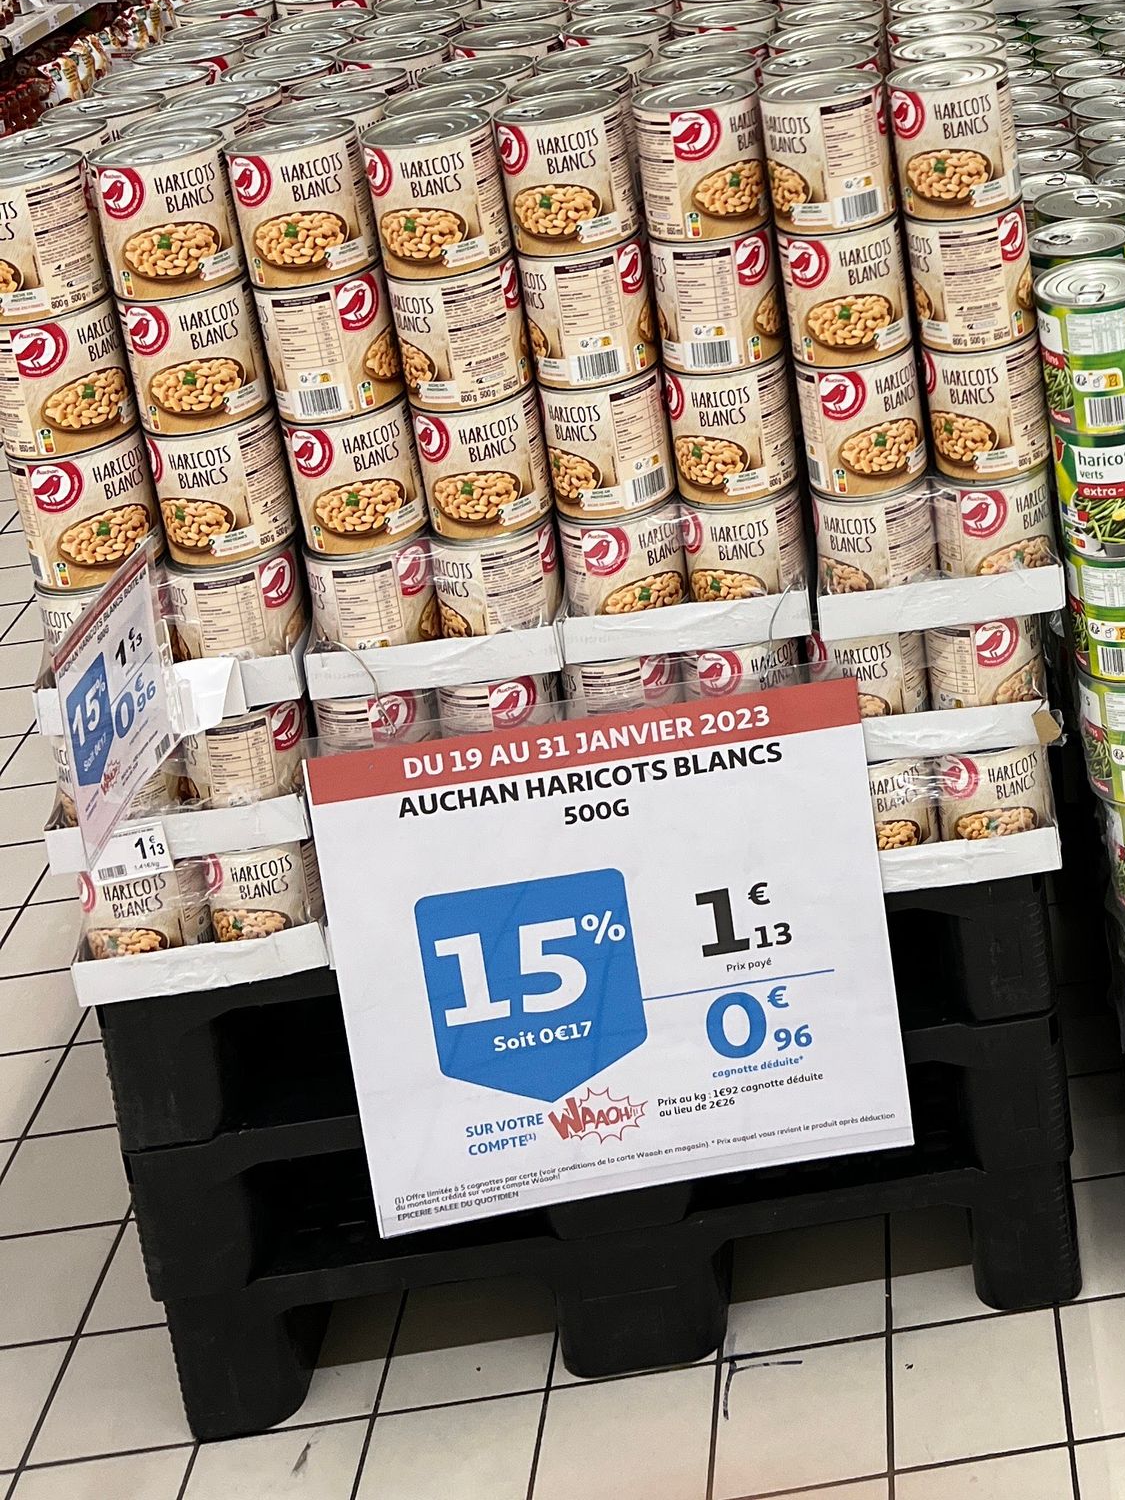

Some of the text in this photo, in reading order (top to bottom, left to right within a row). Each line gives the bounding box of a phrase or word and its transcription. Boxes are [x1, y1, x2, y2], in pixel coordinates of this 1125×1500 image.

[934, 94, 992, 121] HARICOTS
[943, 114, 989, 140] BLANCS
[536, 129, 599, 156] HARICOTS
[546, 149, 597, 174] BLANCS
[153, 162, 216, 194] HARICOTS
[166, 184, 215, 214] BLANCS
[403, 705, 771, 779] DU 19 AU 31 JANVIER 2023
[398, 741, 783, 819] AUCHAN HARICOTS BLANCS
[563, 798, 631, 826] 500G
[230, 854, 293, 884] HARICOTS
[239, 875, 290, 900] BLANCS
[725, 956, 773, 973] Prix payé
[493, 1020, 593, 1053] Soit 0€17
[712, 1062, 759, 1079] cagnotte
[657, 1097, 677, 1107] Prix
[694, 1091, 707, 1104] kg
[713, 1086, 739, 1099] 1€92
[740, 1079, 785, 1094] cagnotte
[786, 1071, 824, 1086] déduite
[674, 1104, 693, 1115] lieu
[709, 1097, 735, 1110] 2€26
[465, 1110, 545, 1138] SUR VOTRE
